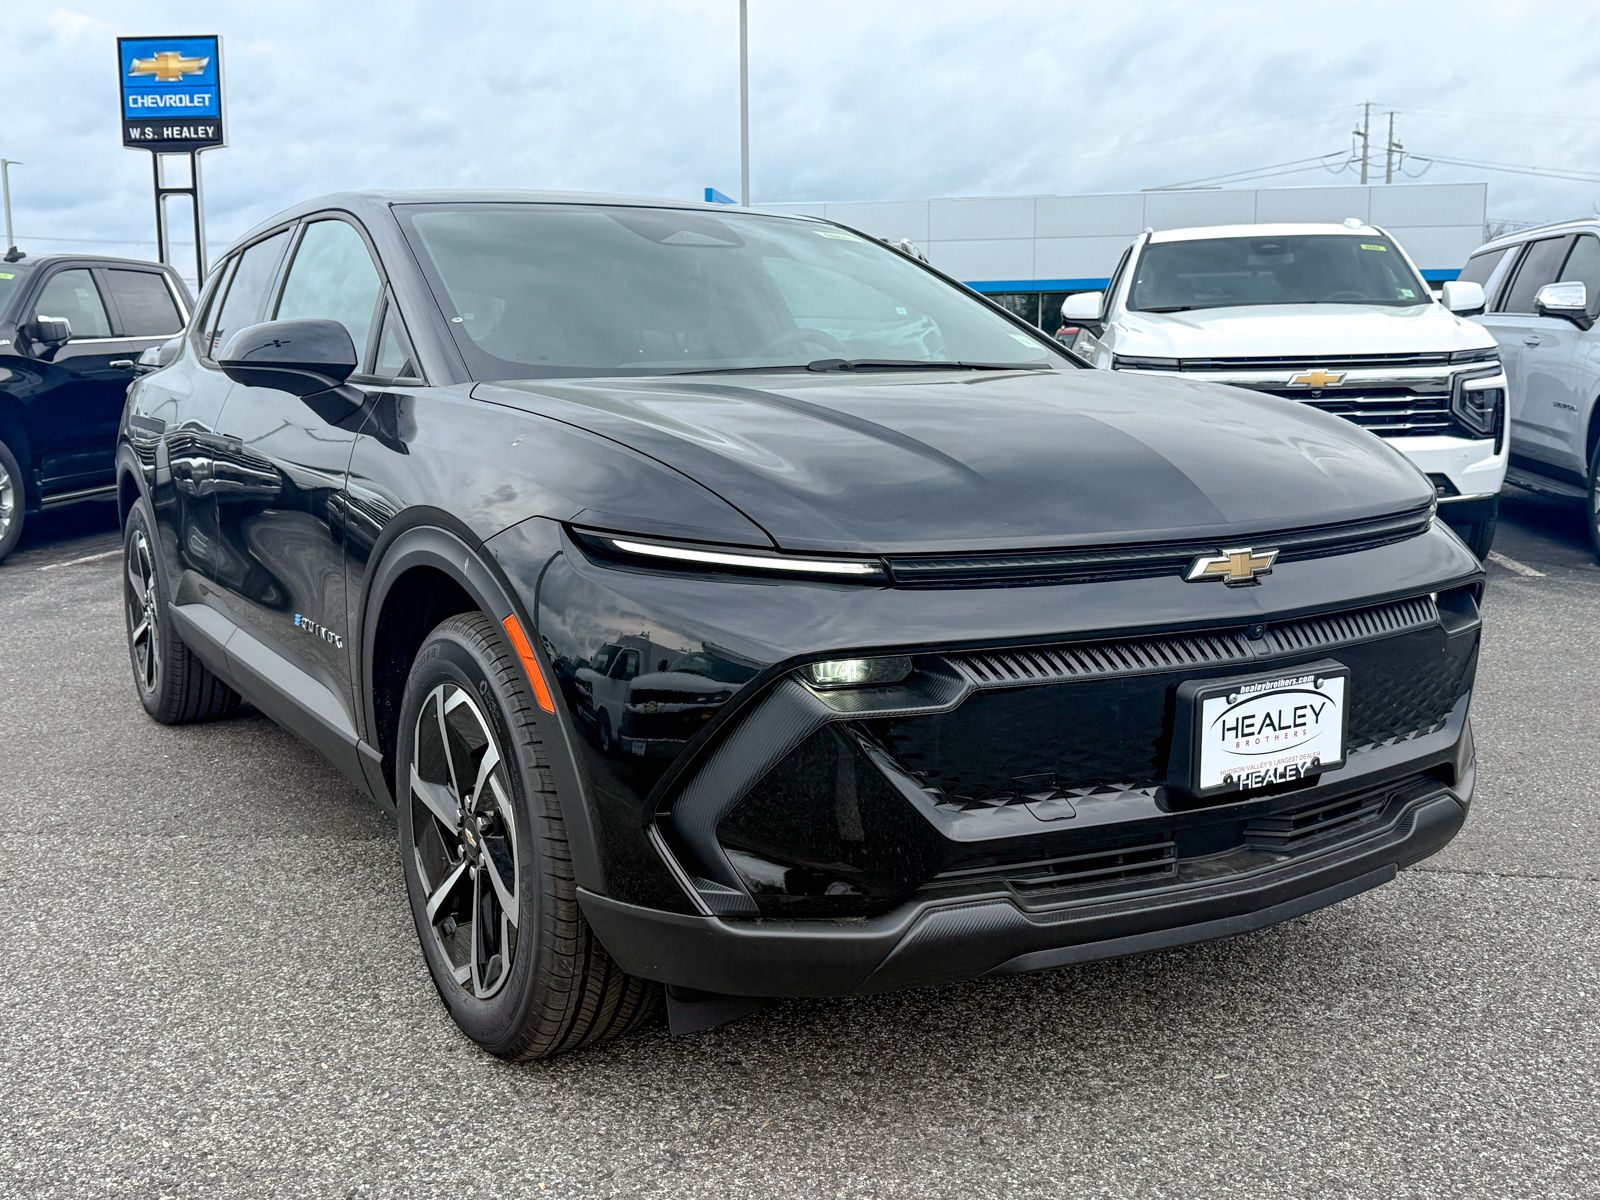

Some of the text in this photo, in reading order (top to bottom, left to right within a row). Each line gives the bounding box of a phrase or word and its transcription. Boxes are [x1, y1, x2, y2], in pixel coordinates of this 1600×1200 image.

[128, 94, 212, 108] CHEVROLET
[129, 126, 215, 139] W.S. HEALEY
[1240, 675, 1315, 694] healeybrothers.com
[1222, 702, 1327, 742] HEALEY
[1235, 729, 1307, 749] BROTHERS
[1246, 760, 1273, 772] VALLEY'S
[1273, 755, 1298, 766] LARGEST
[1239, 761, 1308, 791] HEALEY
